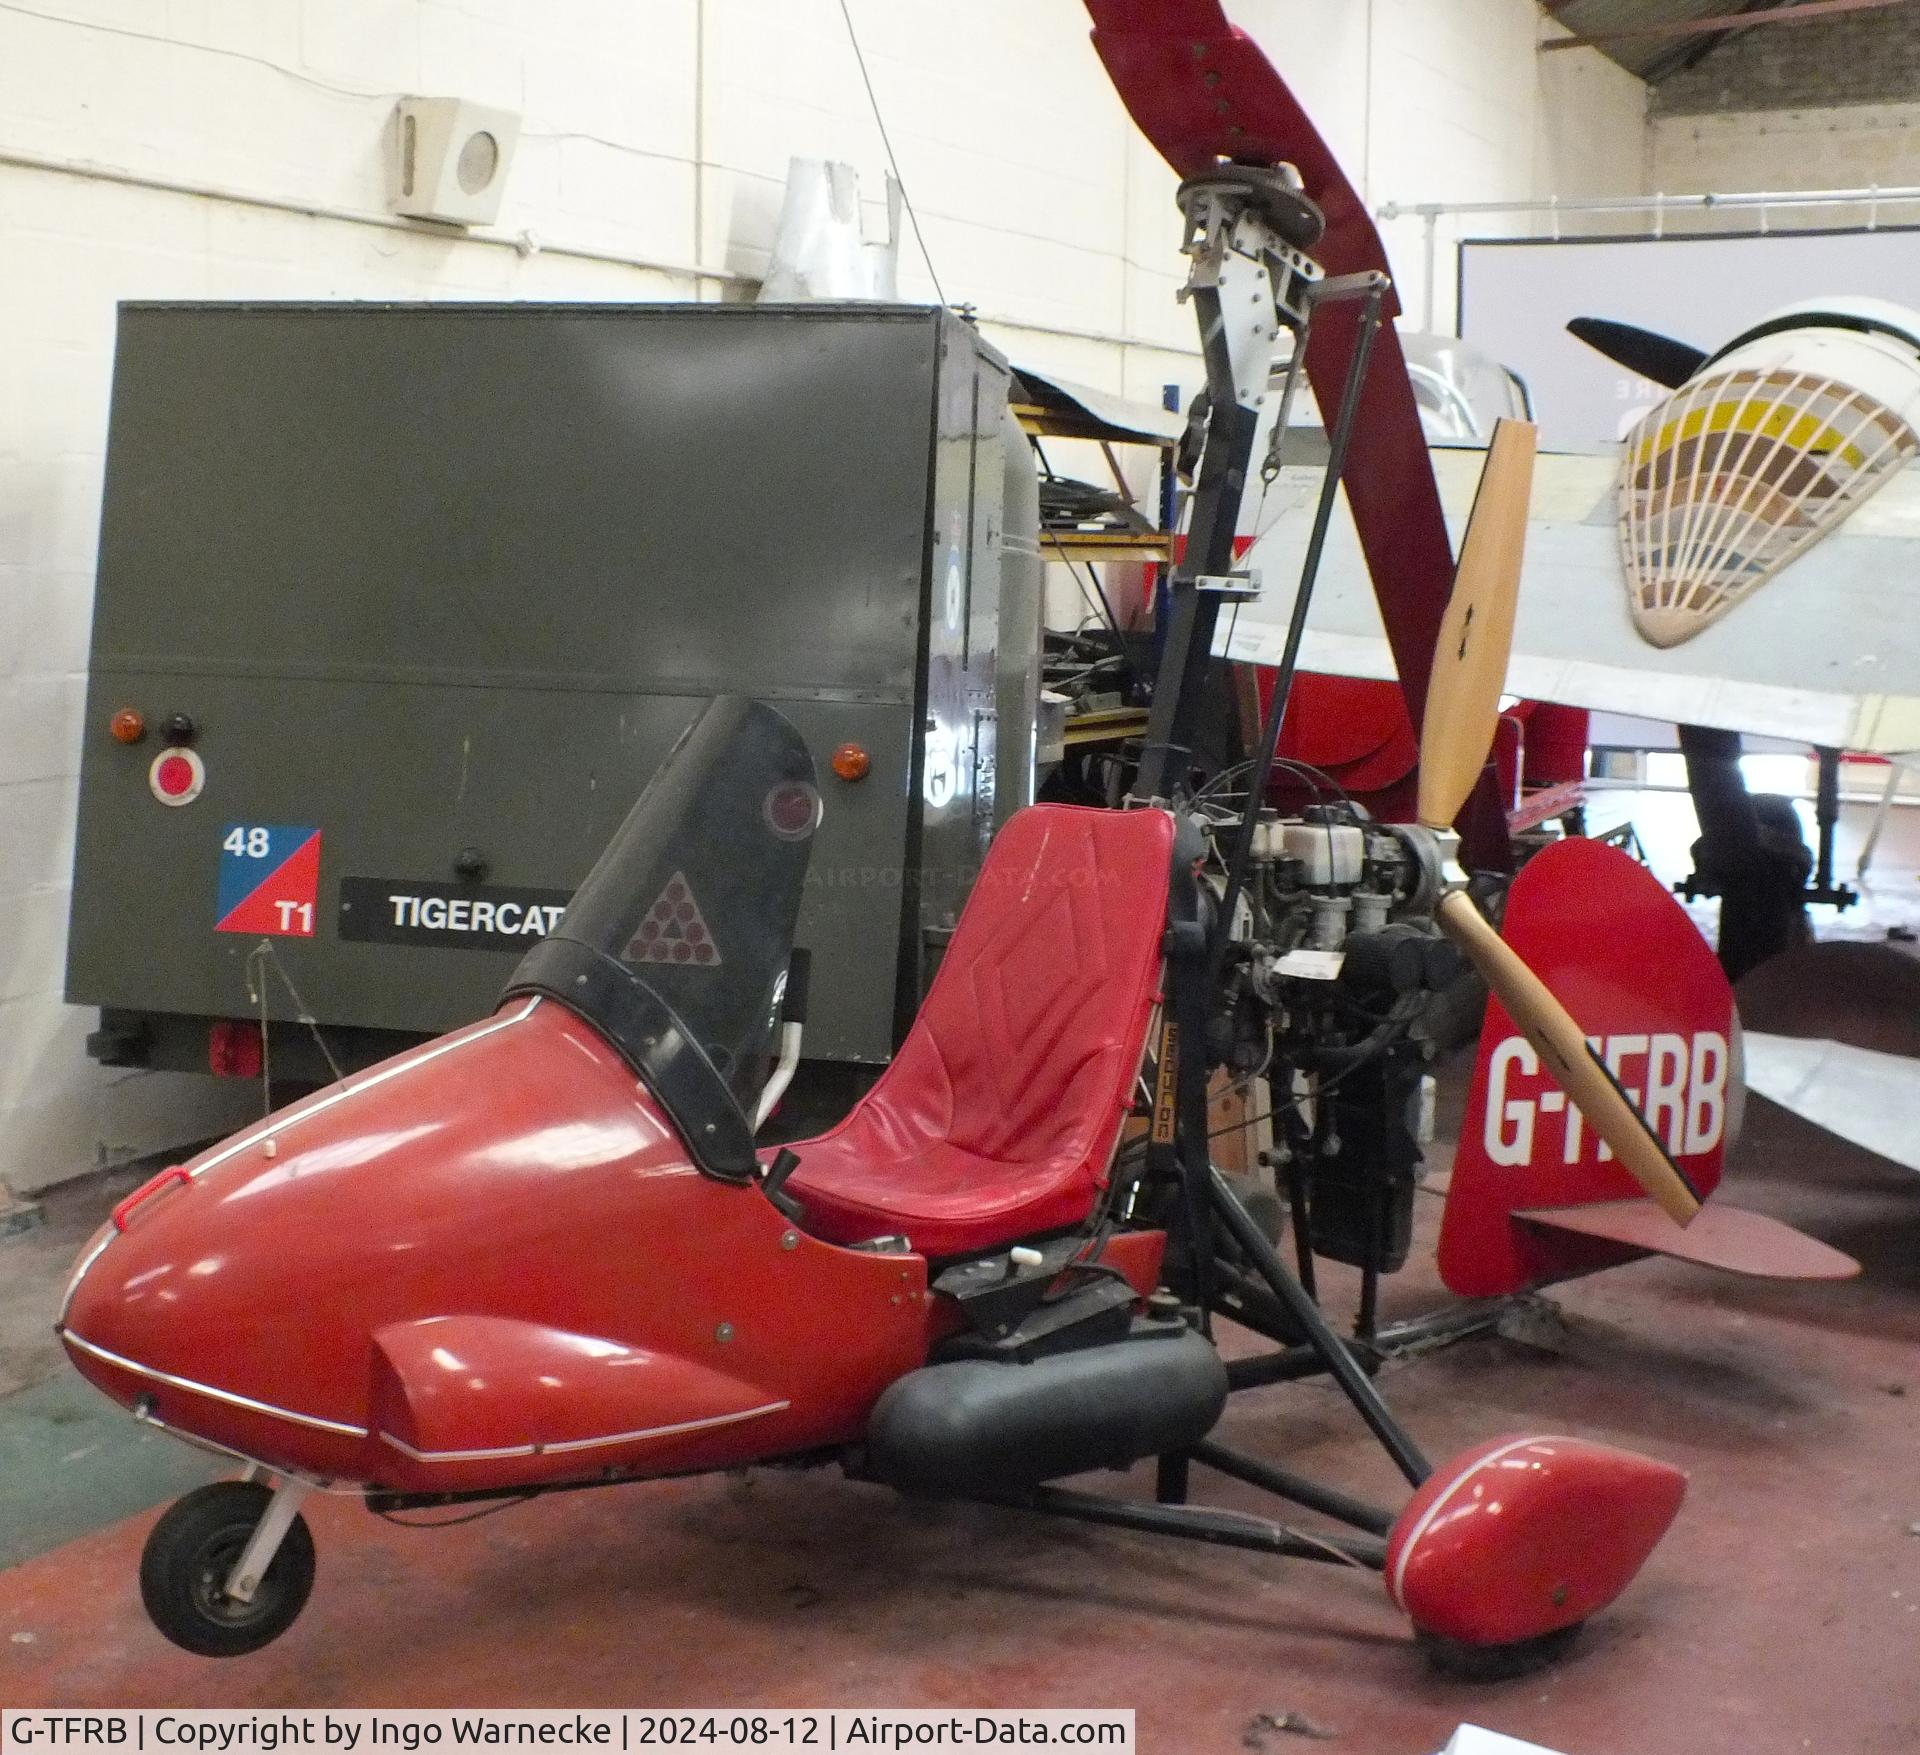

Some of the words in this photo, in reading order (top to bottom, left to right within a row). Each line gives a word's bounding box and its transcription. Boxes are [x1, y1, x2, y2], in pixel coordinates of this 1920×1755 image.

[223, 827, 269, 858] 48
[274, 900, 312, 932] T1
[389, 896, 566, 936] TIGERCAT
